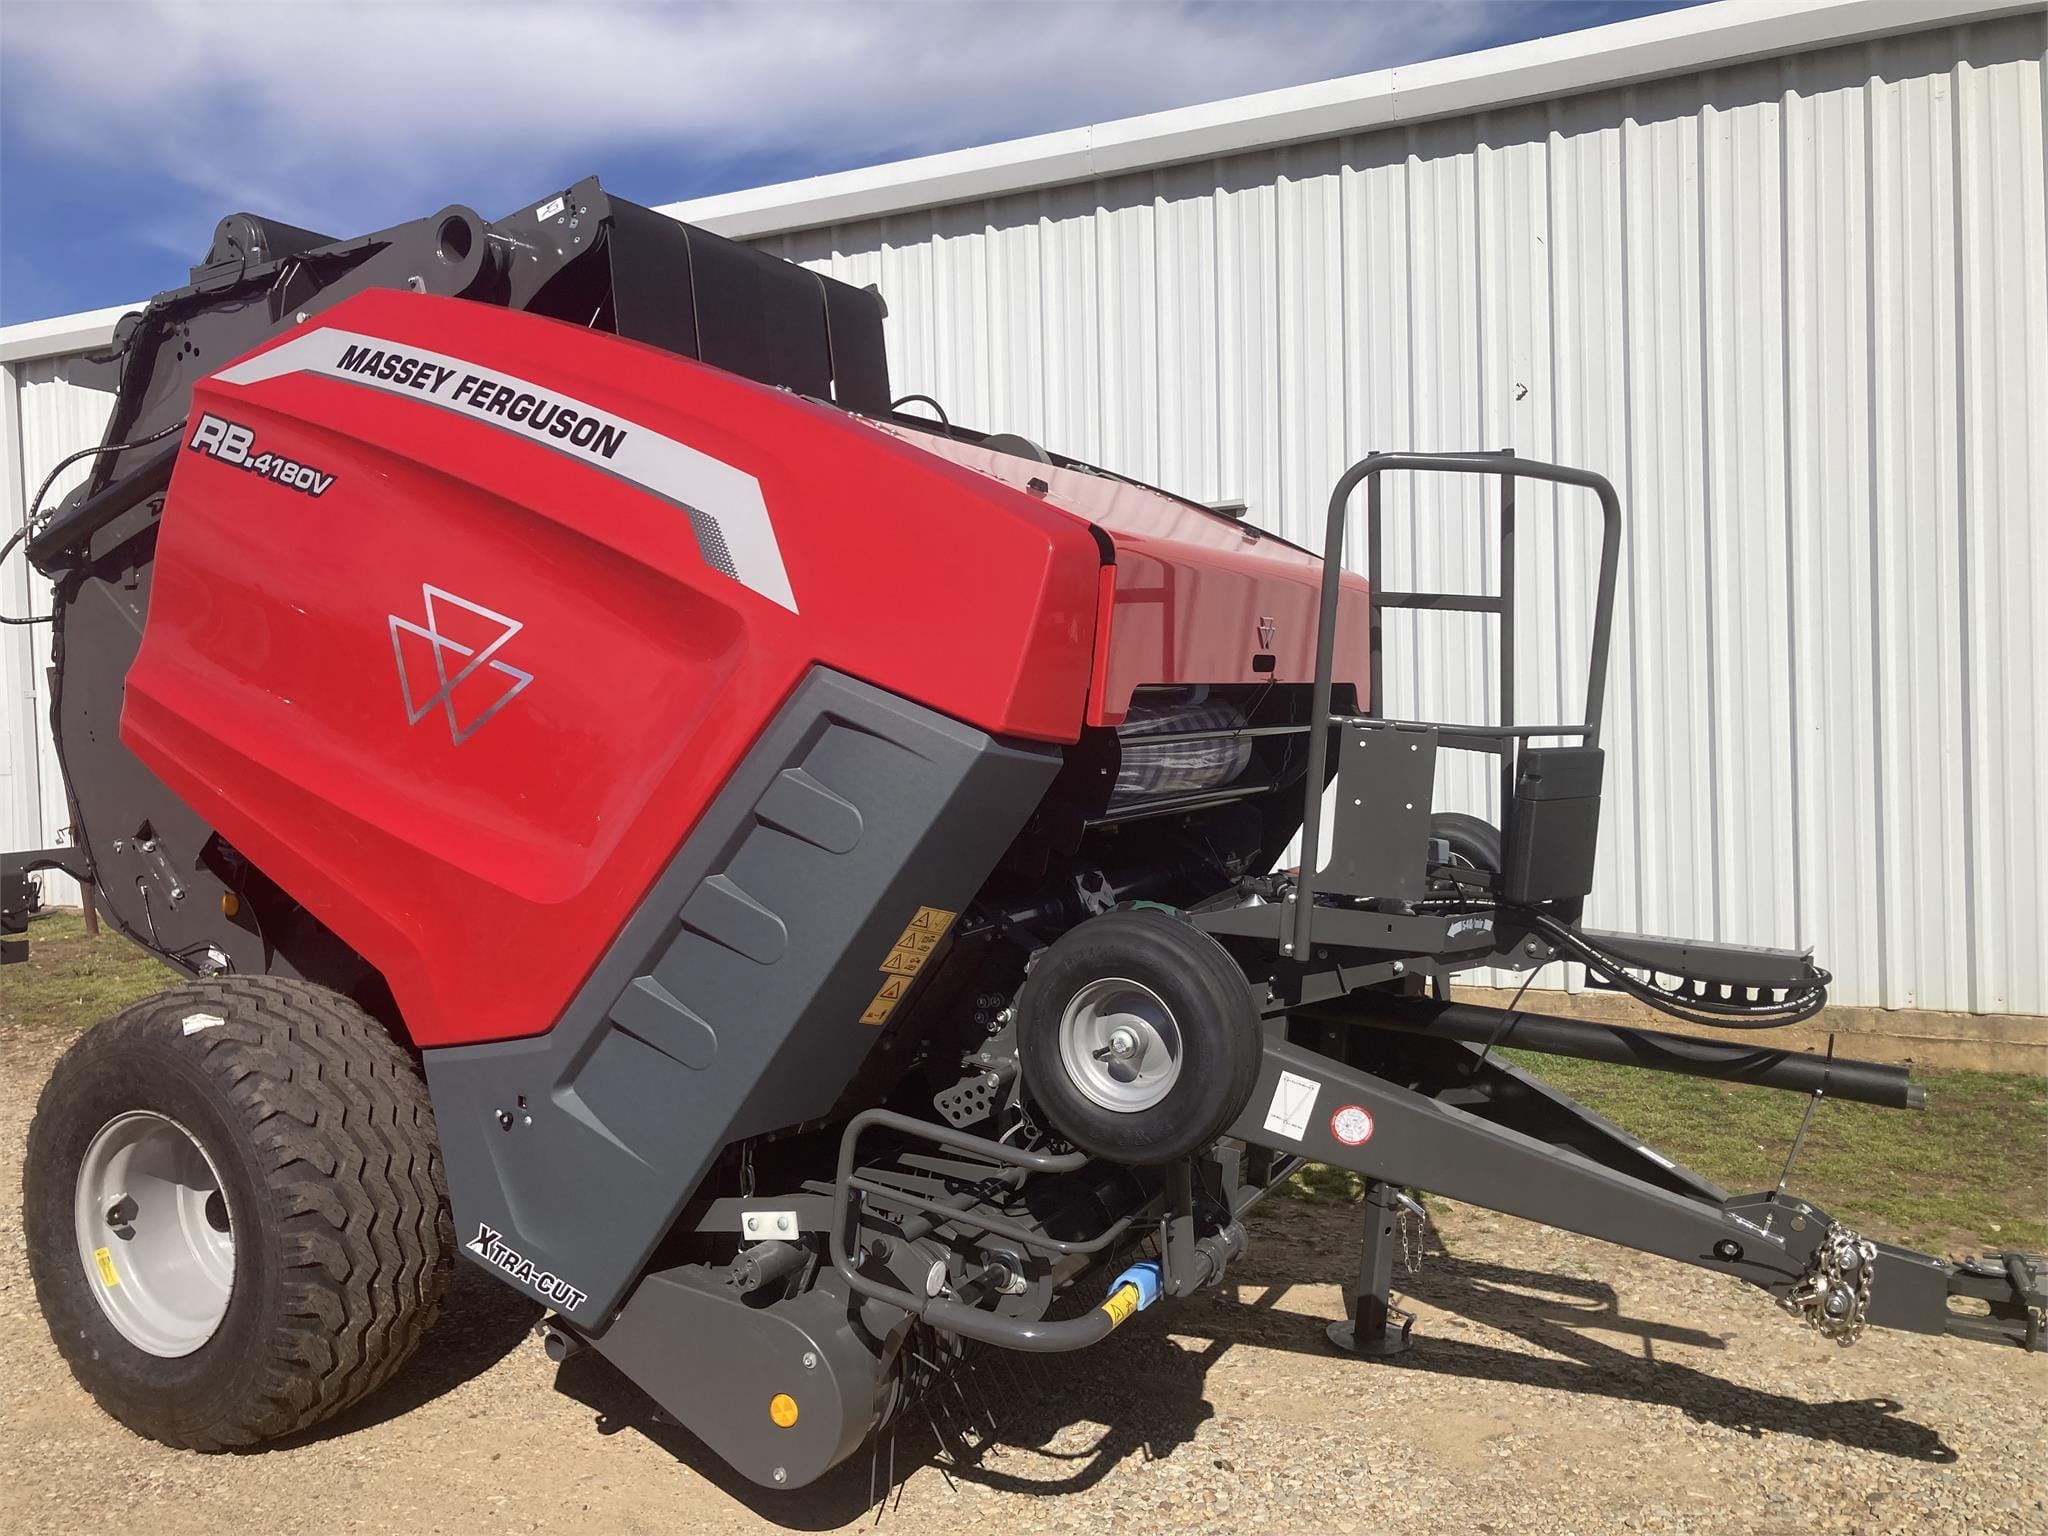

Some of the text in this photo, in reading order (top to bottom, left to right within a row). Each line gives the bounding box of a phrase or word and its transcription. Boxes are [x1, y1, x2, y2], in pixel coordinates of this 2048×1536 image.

[336, 344, 627, 459] MASSEY FERGUSON
[465, 1222, 588, 1311] XTRA-CUT
